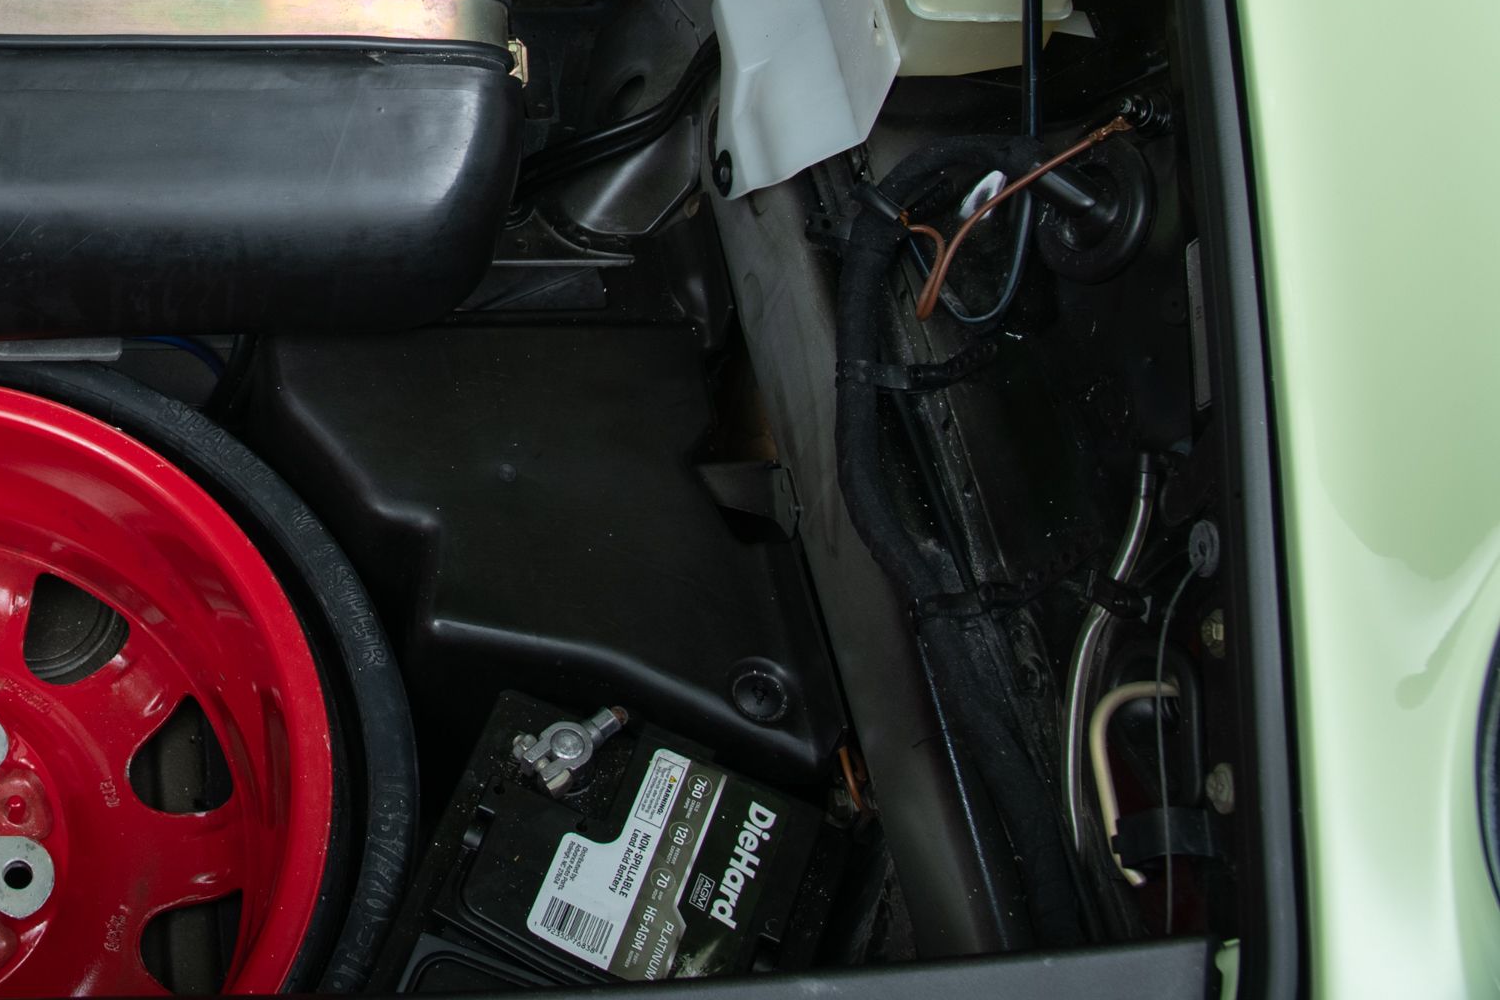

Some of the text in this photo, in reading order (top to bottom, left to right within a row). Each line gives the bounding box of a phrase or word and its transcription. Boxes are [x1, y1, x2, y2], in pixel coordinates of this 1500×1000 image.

[656, 783, 674, 816] WARNING:
[690, 777, 708, 799] 760
[672, 825, 689, 845] 120
[608, 828, 641, 893] Lead Acid Battery
[619, 833, 651, 898] NON-SPILLABLE
[708, 801, 778, 929] DieHard
[656, 872, 670, 889] 70
[696, 879, 712, 907] AGM
[631, 905, 658, 951] H6-AGM
[644, 921, 674, 981] PLATINUM
